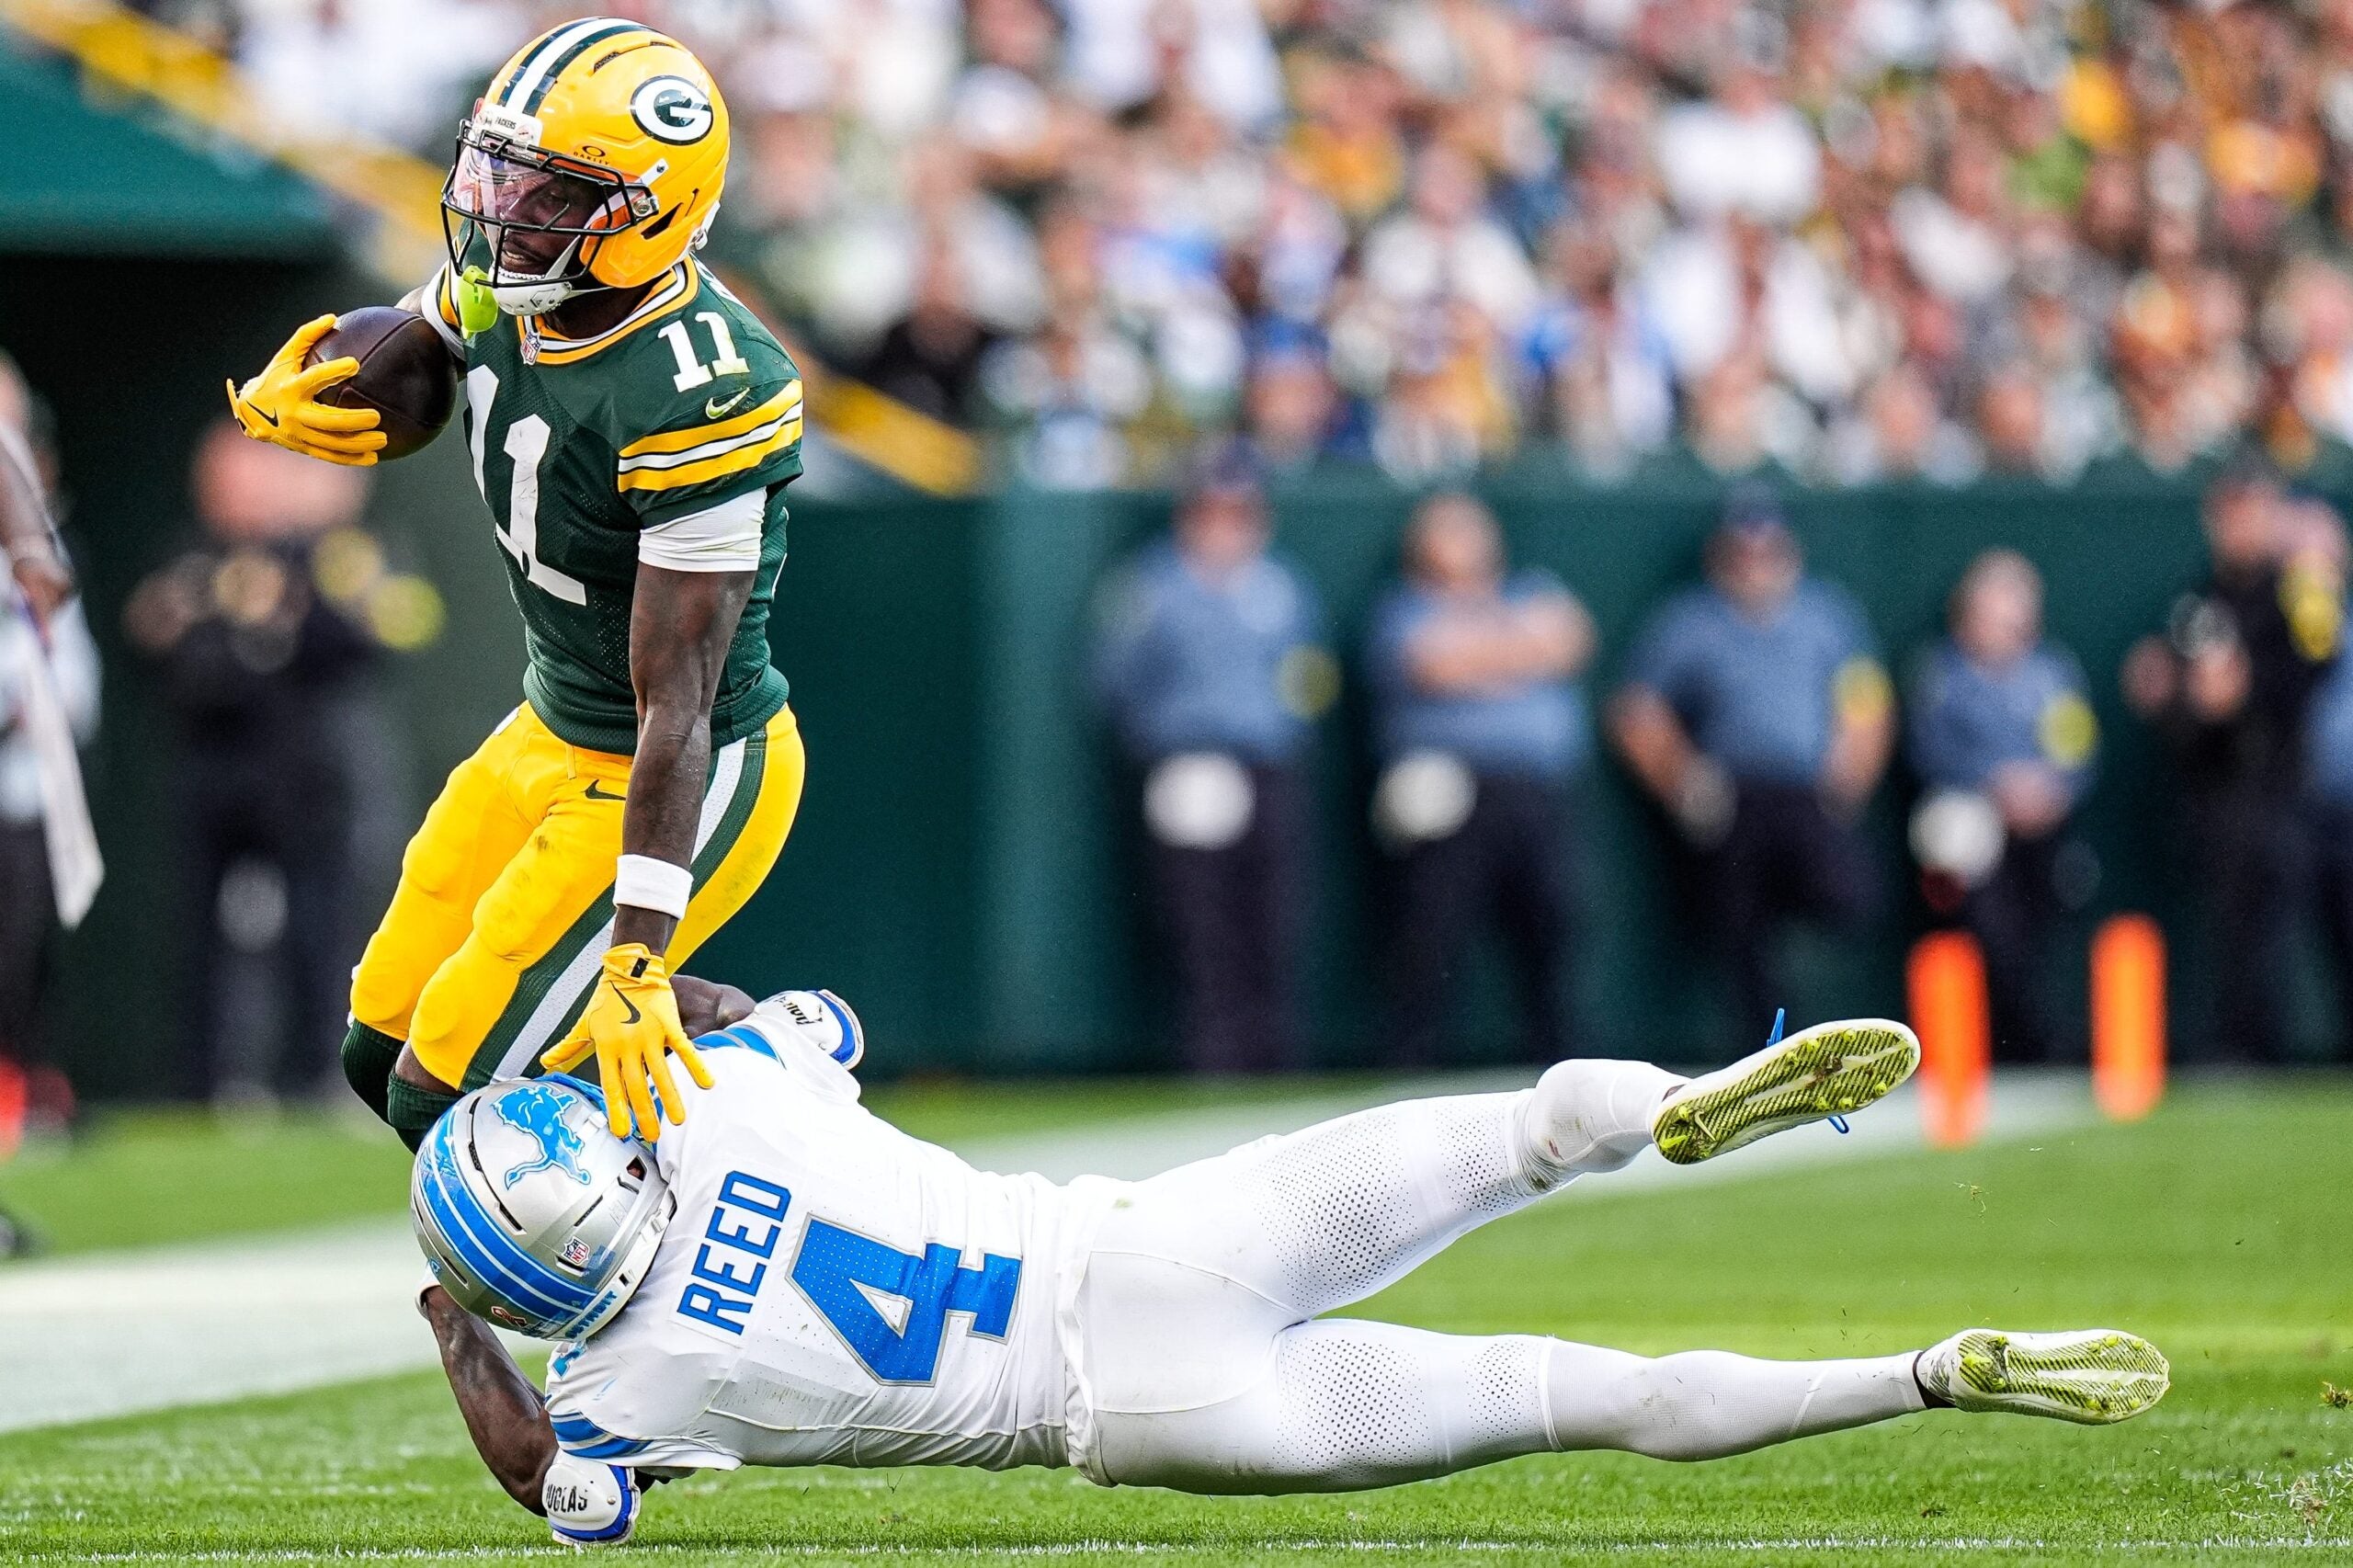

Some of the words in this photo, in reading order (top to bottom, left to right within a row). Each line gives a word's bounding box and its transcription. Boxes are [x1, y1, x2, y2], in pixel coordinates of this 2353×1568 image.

[631, 75, 713, 145] G
[657, 312, 750, 392] 11
[571, 1244, 588, 1263] NFL
[678, 1170, 791, 1335] REED
[786, 1211, 1022, 1387] 4
